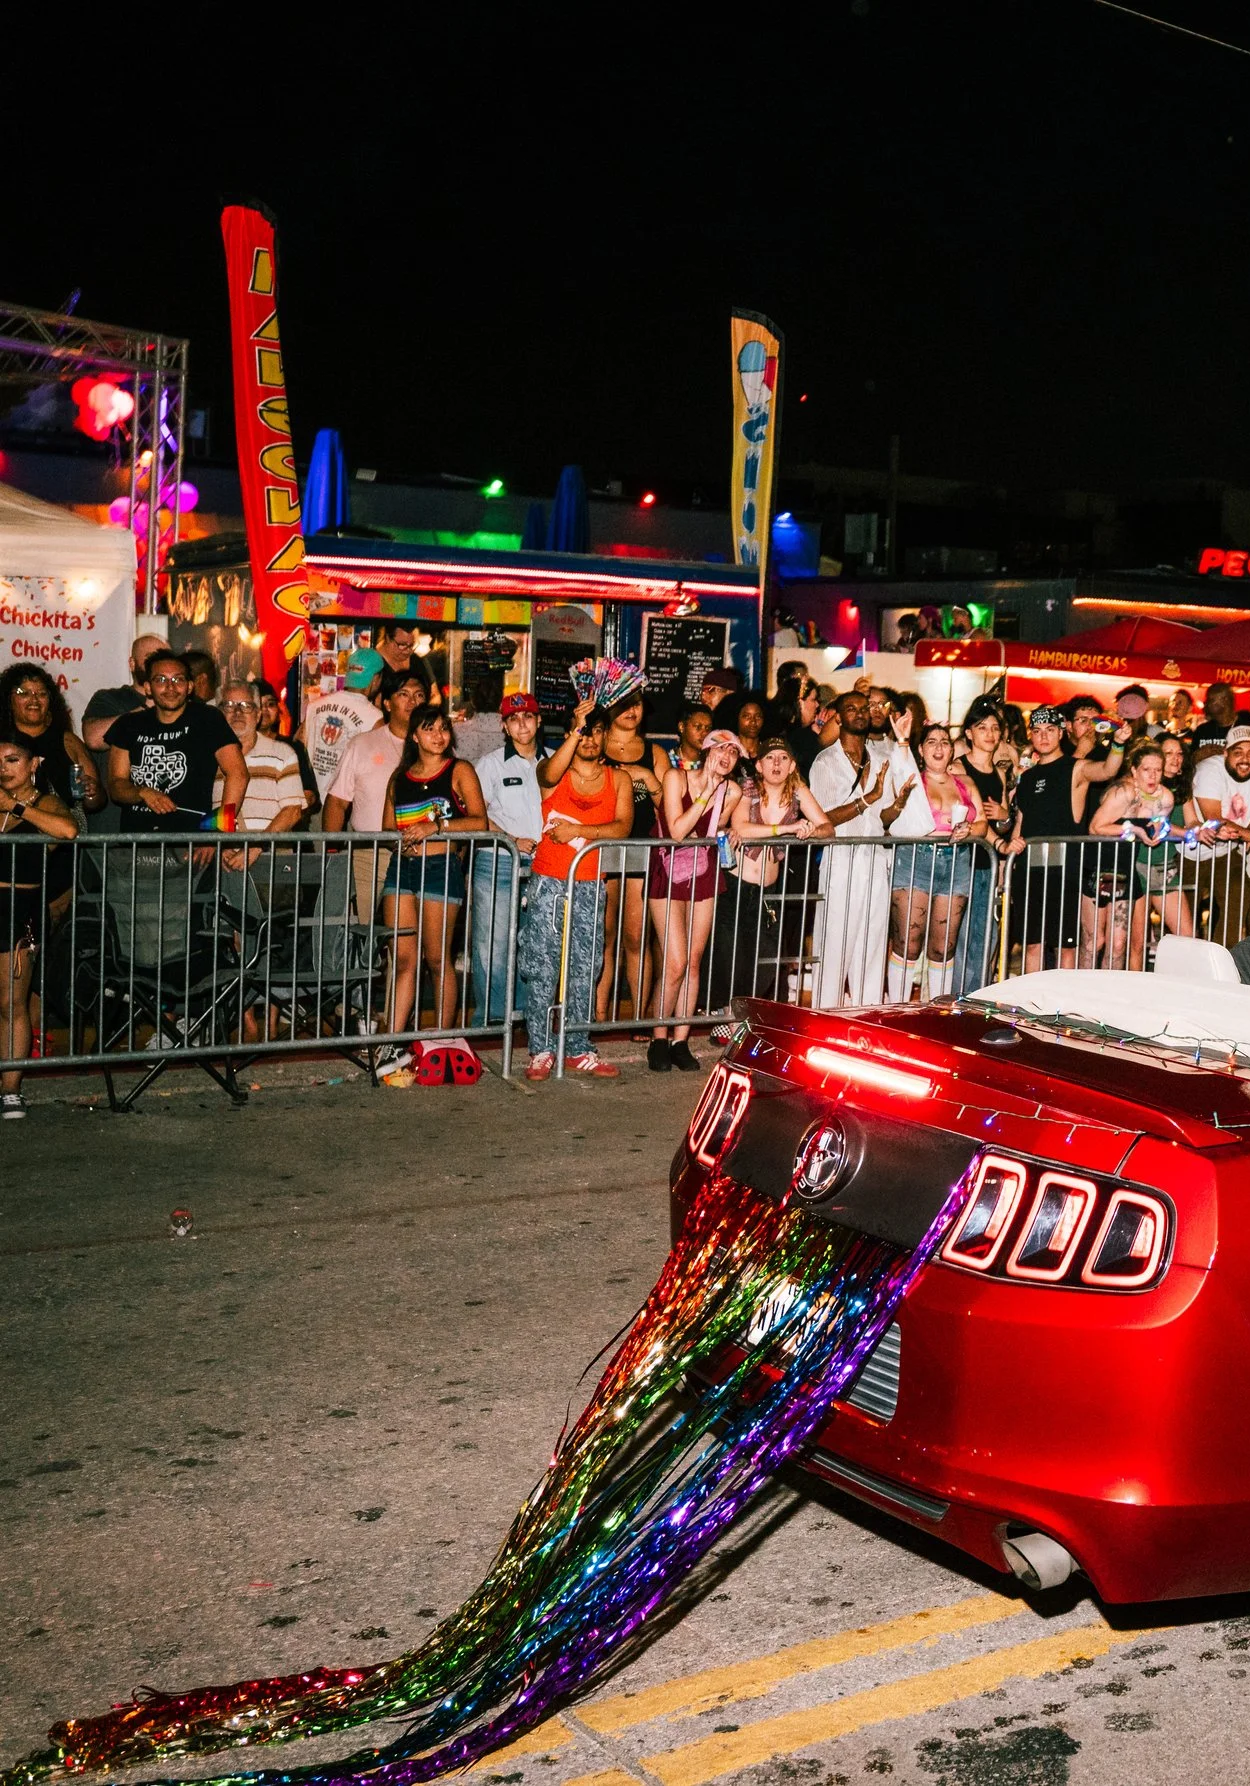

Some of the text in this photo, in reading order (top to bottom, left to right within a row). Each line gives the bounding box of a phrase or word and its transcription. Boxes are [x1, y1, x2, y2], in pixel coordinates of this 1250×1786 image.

[0, 605, 96, 630] Chickita's
[11, 639, 83, 662] Chicken
[1029, 650, 1128, 673] HAMBURGUESAS
[315, 703, 364, 728] BORN IN THE
